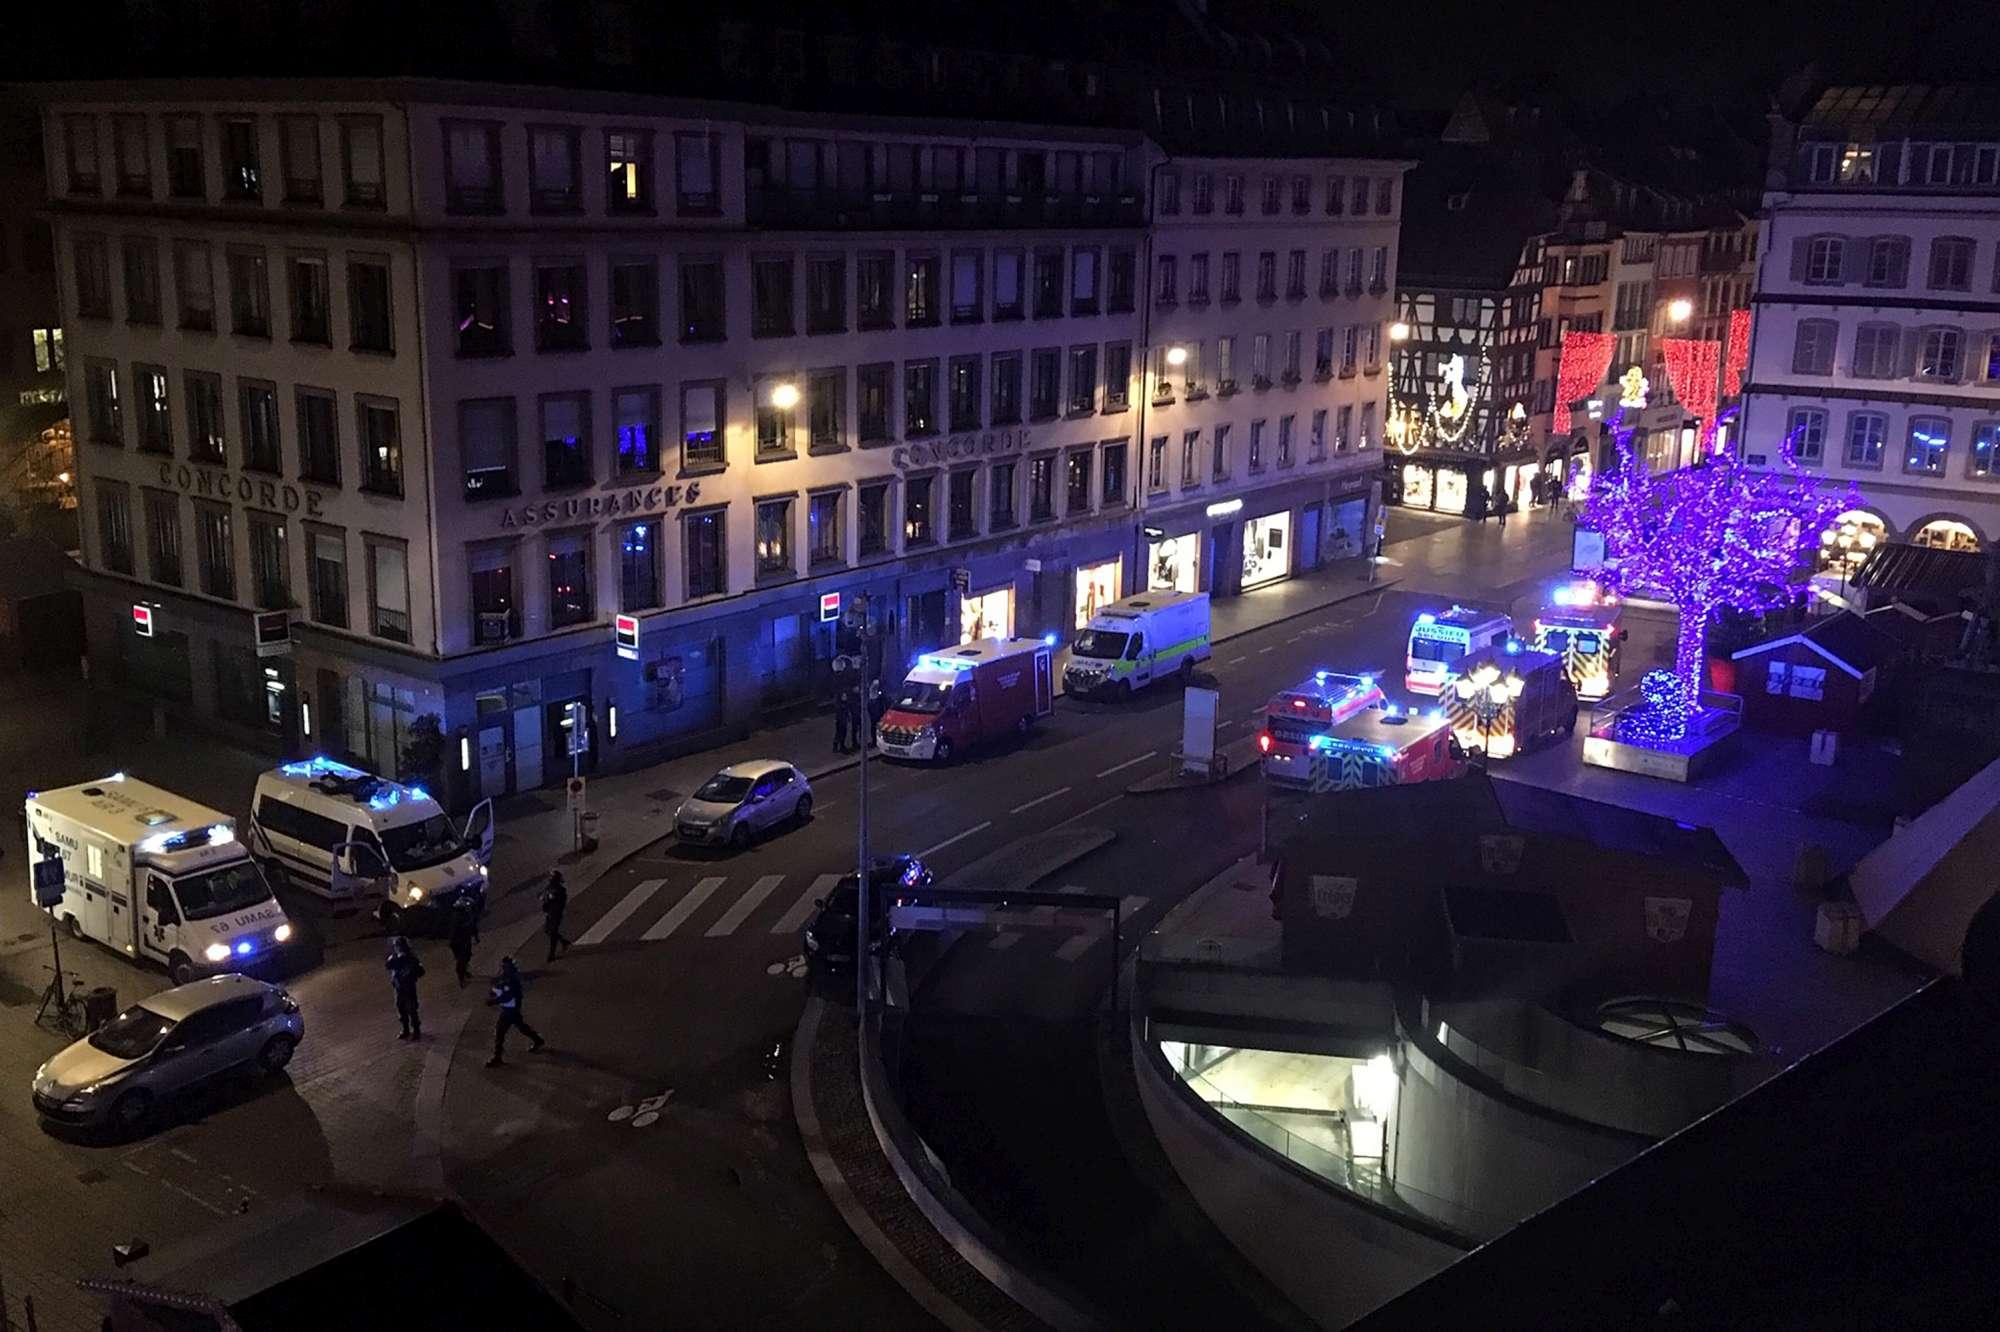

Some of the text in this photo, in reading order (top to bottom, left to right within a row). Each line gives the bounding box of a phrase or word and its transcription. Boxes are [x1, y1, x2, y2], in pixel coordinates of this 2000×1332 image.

[891, 430, 1031, 470] CONCORDE
[159, 462, 323, 516] CONCORDE
[502, 481, 701, 528] ASSURANCES
[55, 832, 79, 850] SAMU
